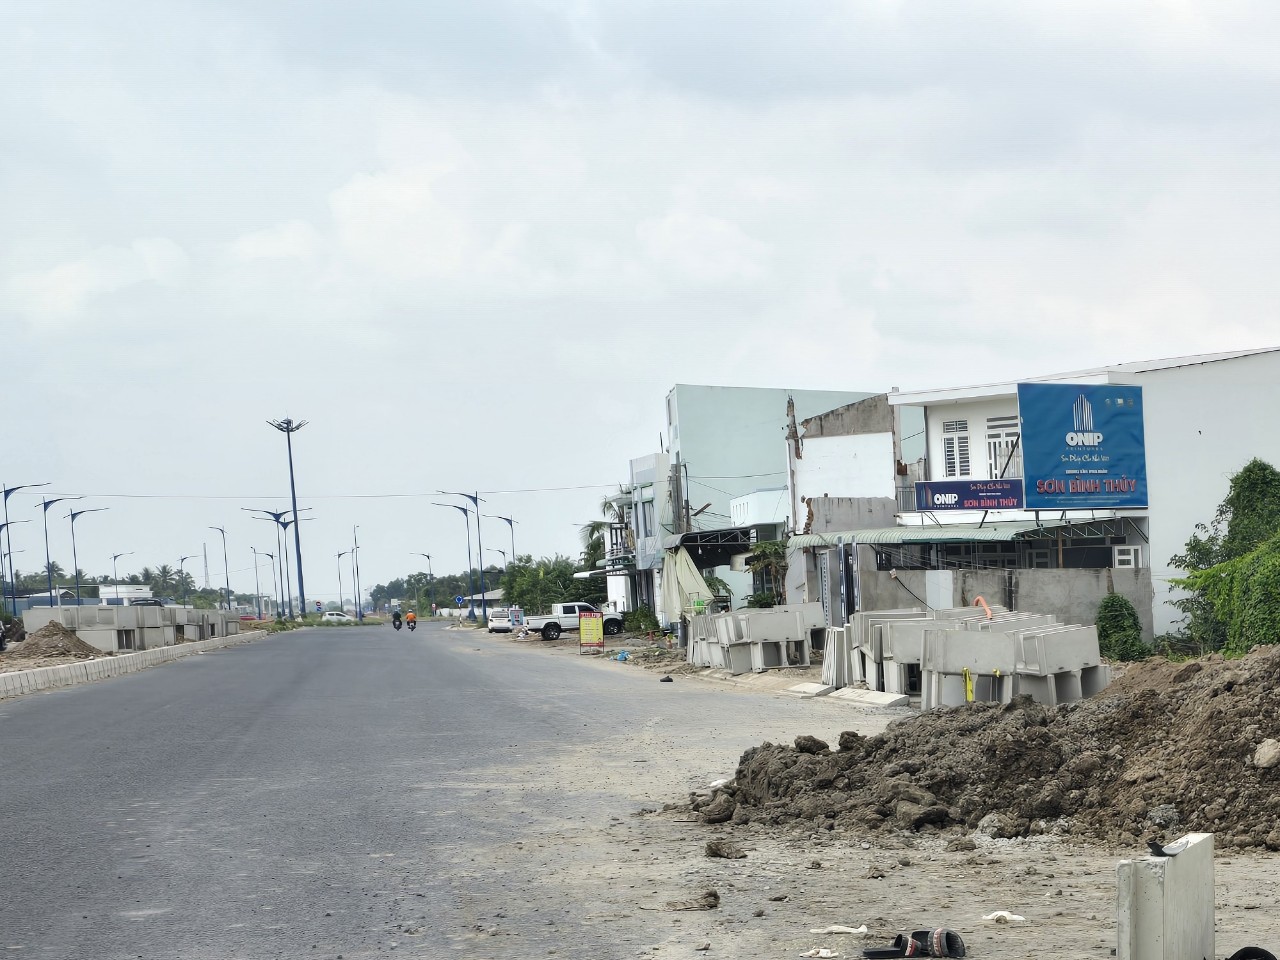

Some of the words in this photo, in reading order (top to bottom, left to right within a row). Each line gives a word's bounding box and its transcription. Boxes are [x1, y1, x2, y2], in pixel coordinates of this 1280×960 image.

[1065, 432, 1103, 446] ONIP
[1036, 478, 1066, 494] SƠN
[1069, 476, 1101, 493] BÌNH
[934, 493, 958, 505] ONIP
